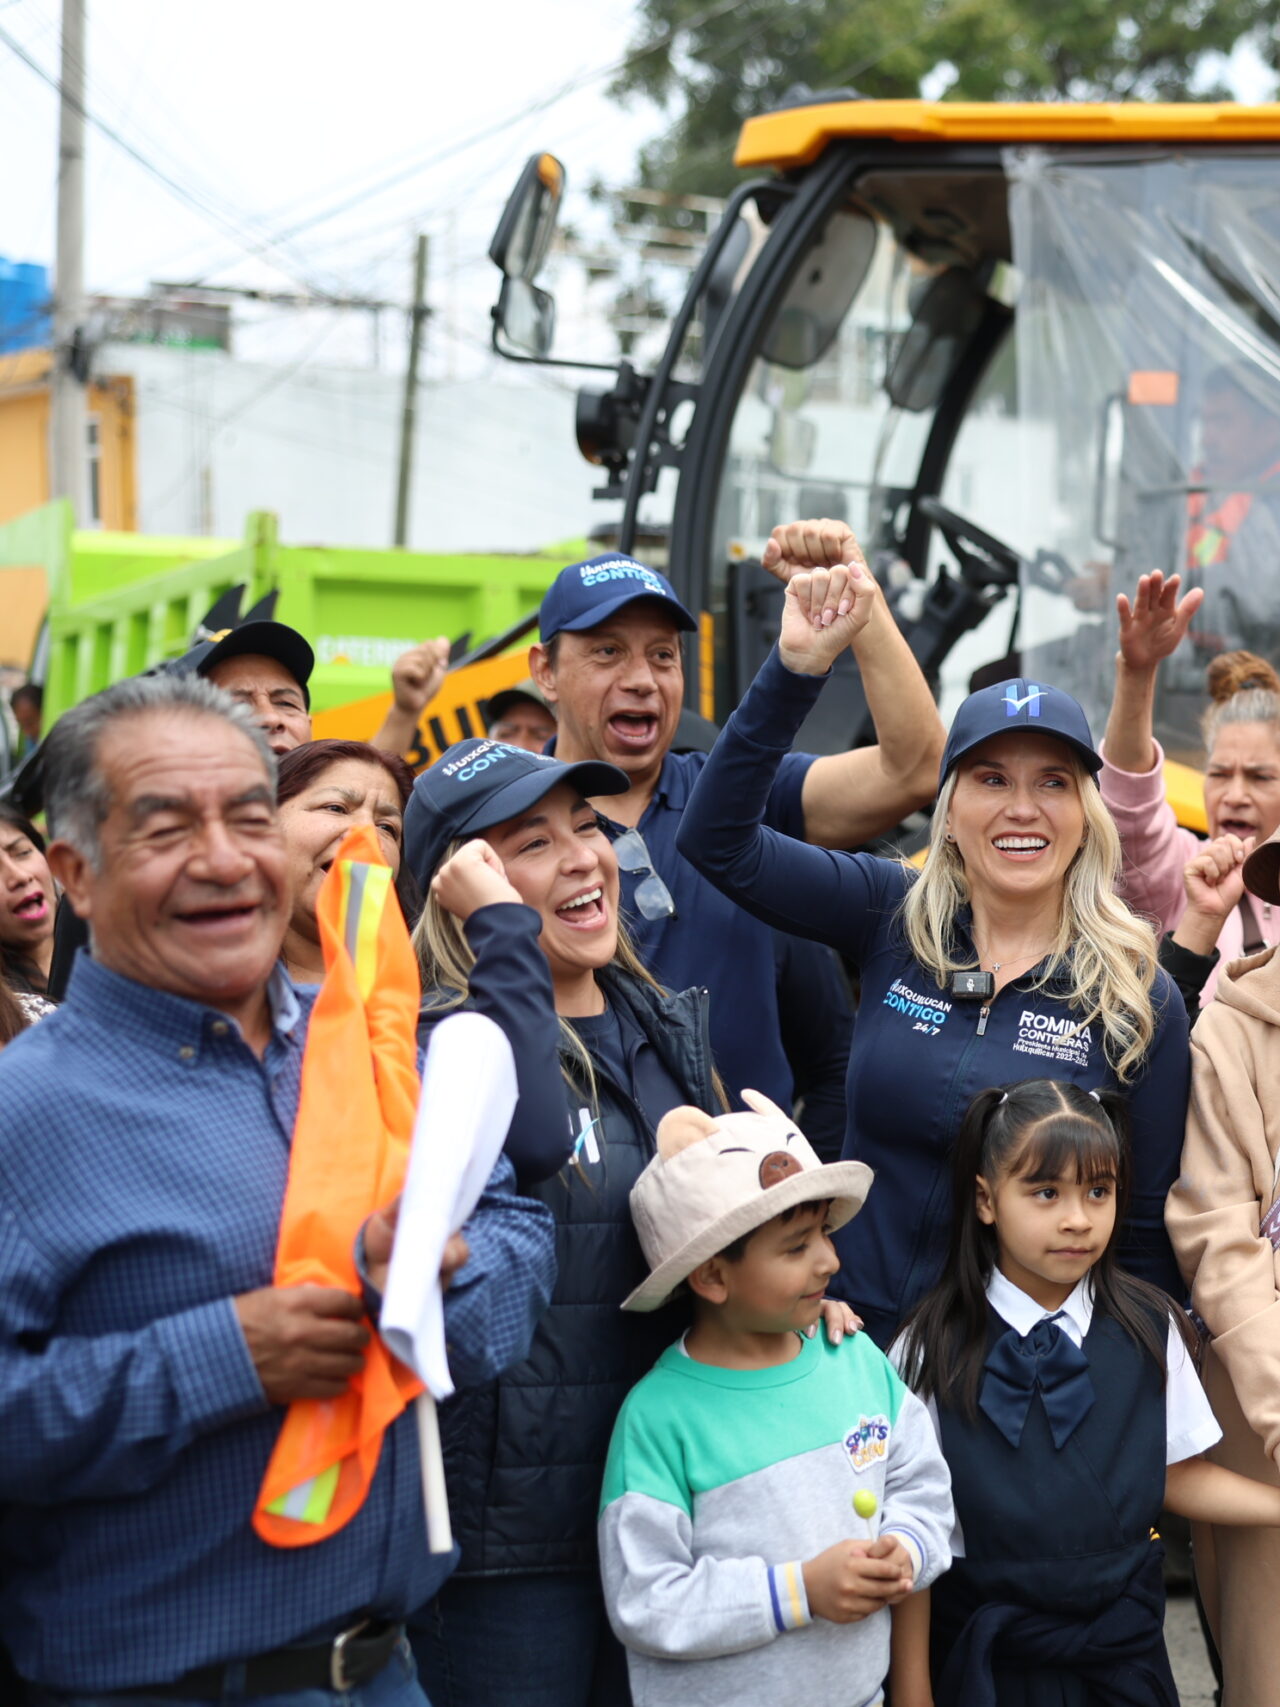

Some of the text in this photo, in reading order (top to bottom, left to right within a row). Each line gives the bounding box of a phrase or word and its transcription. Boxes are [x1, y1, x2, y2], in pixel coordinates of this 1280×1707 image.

[882, 991, 947, 1025] CONTIGO
[912, 1021, 942, 1037] 24/7
[1018, 1010, 1093, 1044] ROMINA
